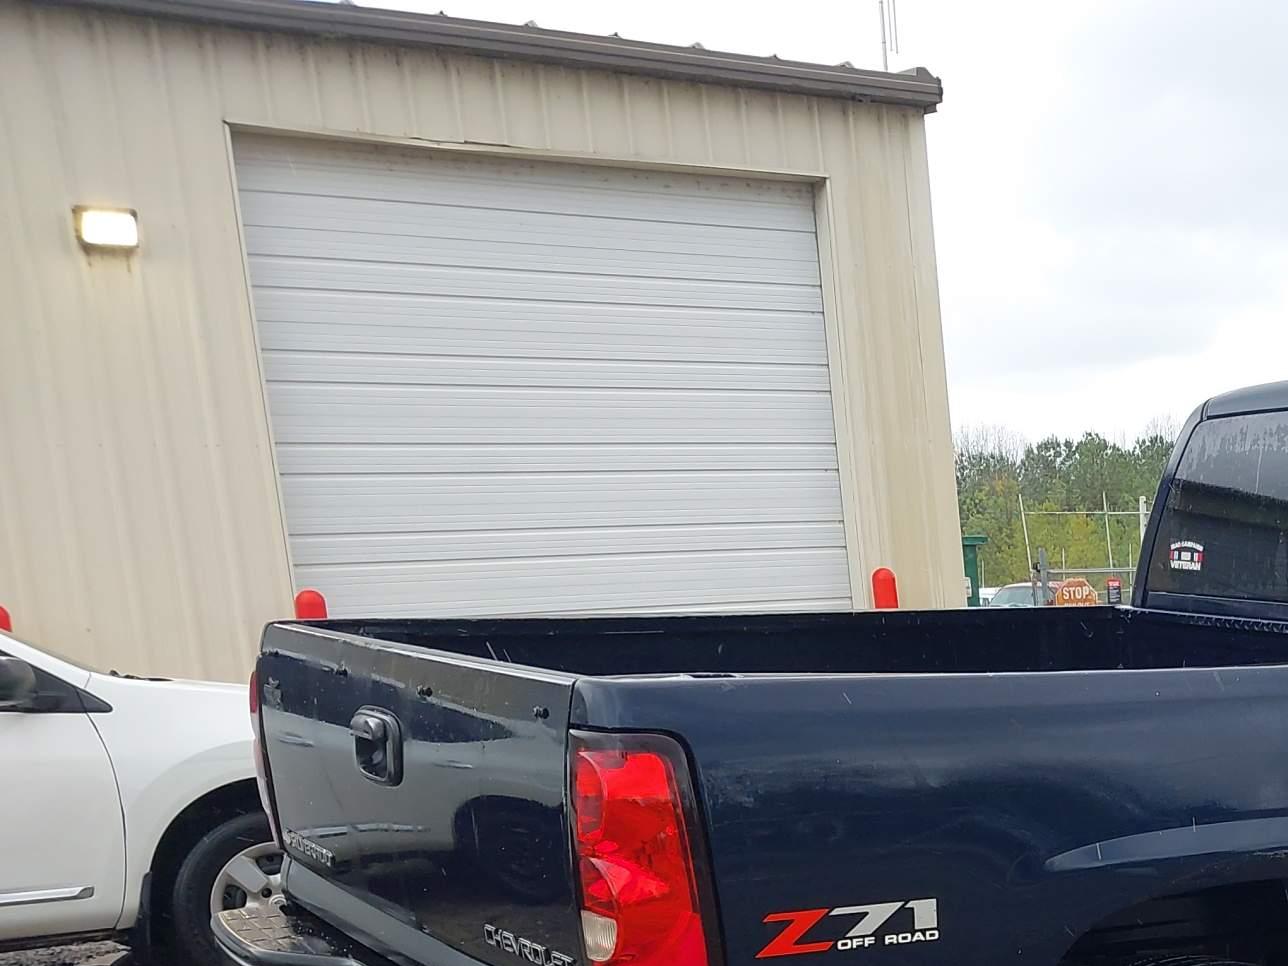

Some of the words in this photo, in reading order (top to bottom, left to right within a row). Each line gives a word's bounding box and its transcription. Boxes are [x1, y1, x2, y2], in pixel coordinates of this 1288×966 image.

[1169, 559, 1201, 570] VETERAN
[1062, 586, 1090, 600] STOP
[755, 898, 938, 958] Z71
[837, 936, 876, 950] OFF
[884, 929, 940, 945] ROAD
